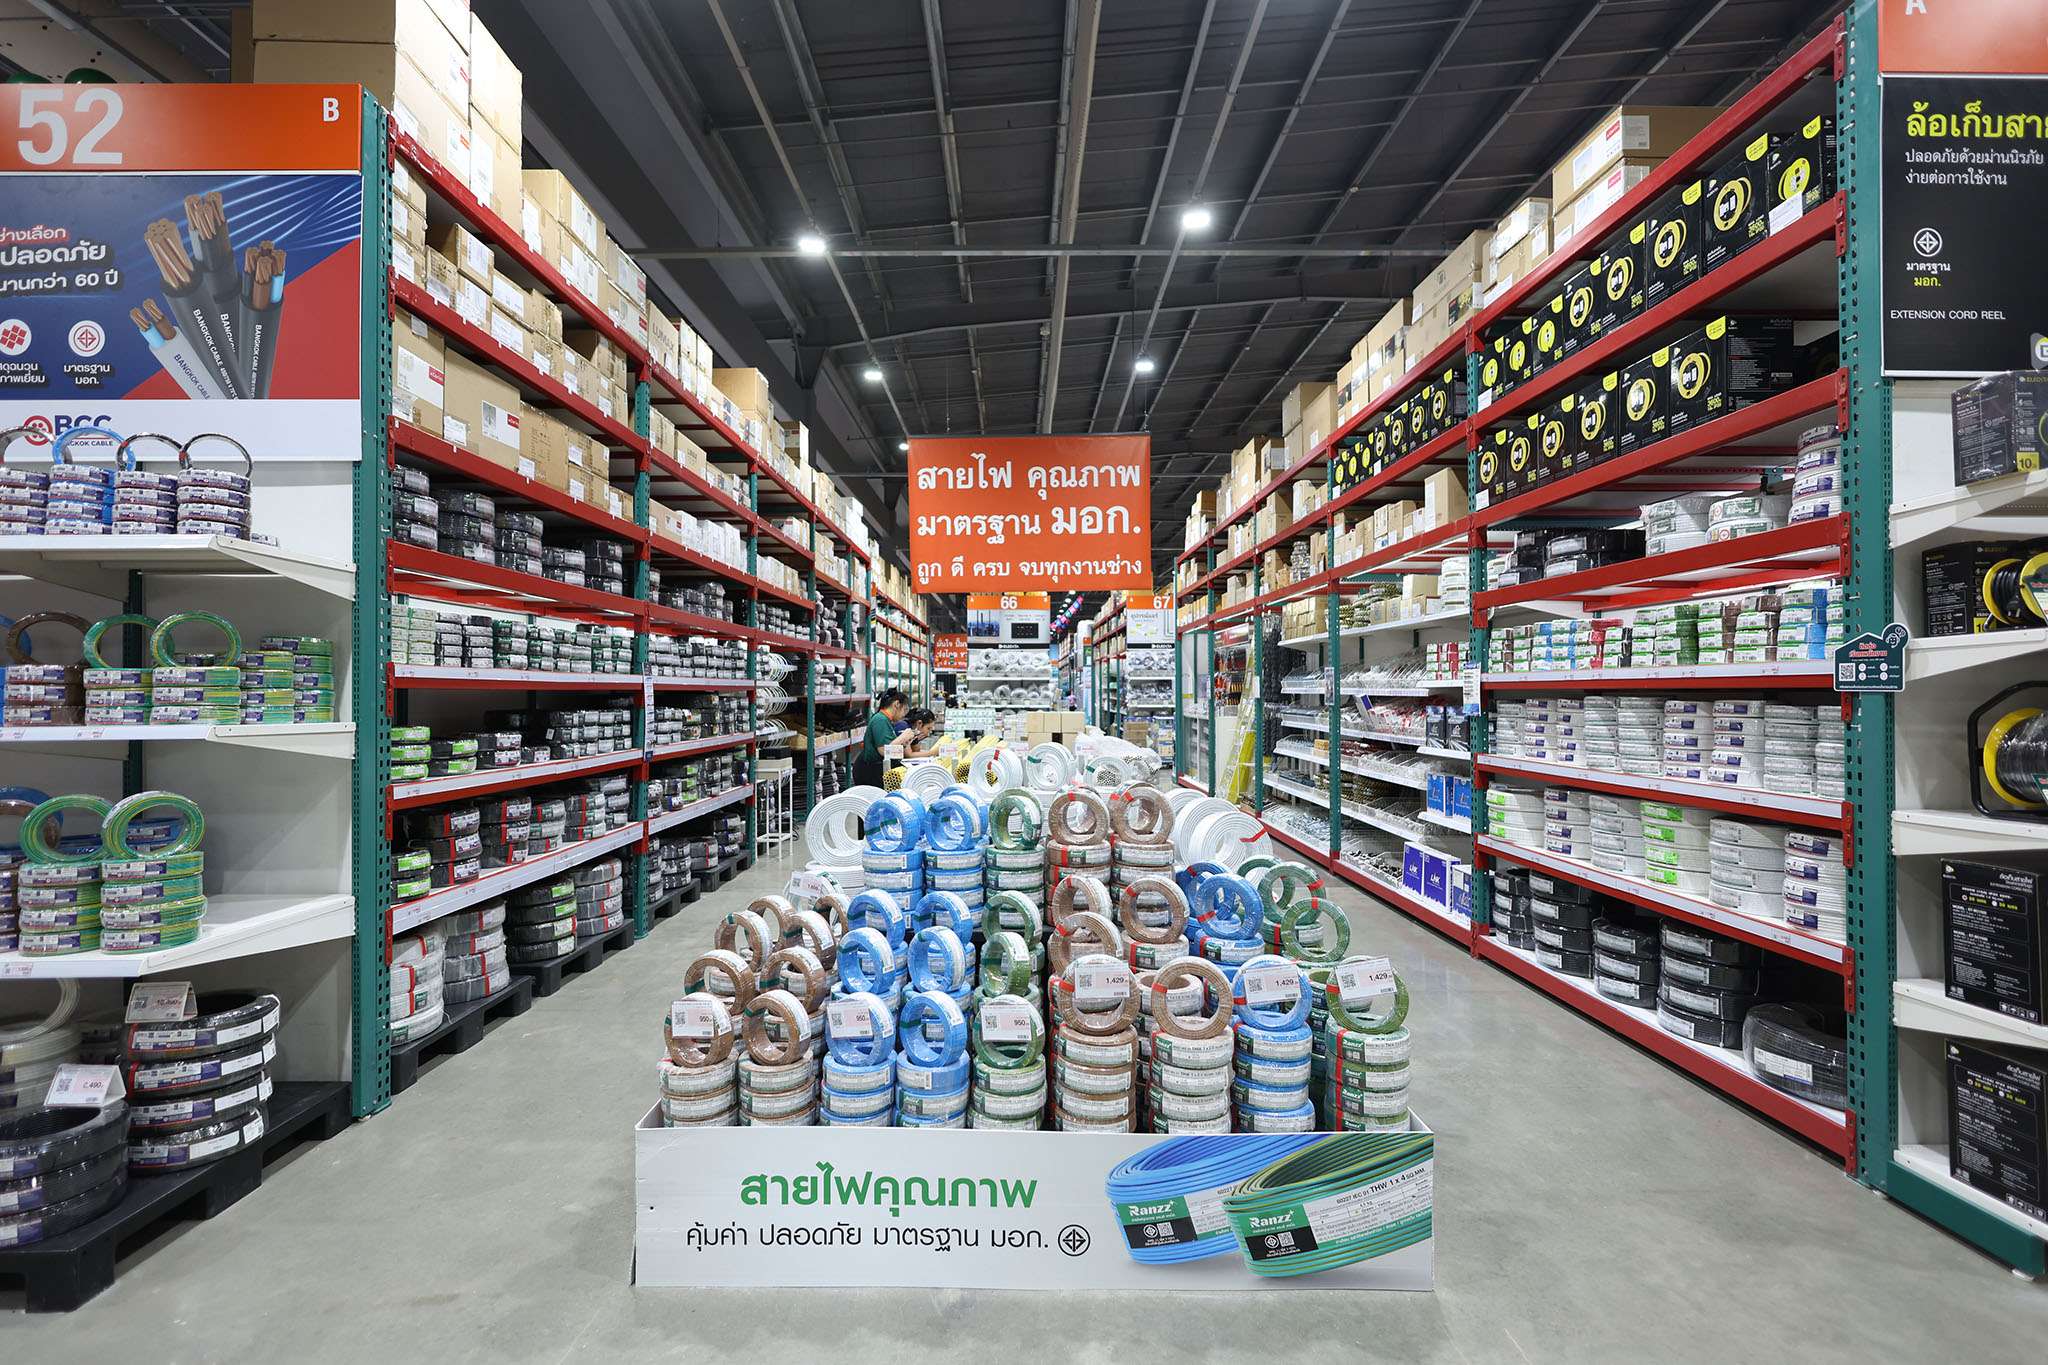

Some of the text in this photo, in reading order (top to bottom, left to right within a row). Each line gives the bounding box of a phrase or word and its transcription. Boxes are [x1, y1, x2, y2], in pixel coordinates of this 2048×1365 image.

[1905, 0, 1927, 15] A
[323, 98, 340, 122] B
[18, 88, 124, 165] 52
[1906, 101, 2048, 138] ล้อเก็บสา
[1905, 148, 2044, 165] ปลอดภัยด้วยม่านนิรภัย
[1905, 168, 2008, 186] ง่ายต่อการใช้งาน
[1, 240, 106, 266] ปลอดภัย
[1906, 262, 1951, 273] มาตรฐาน
[75, 273, 99, 287] 60
[105, 268, 119, 285] ปี
[1914, 276, 1941, 287] มอก.
[1891, 310, 2006, 320] EXTENSION CORD REEL
[193, 308, 214, 347] BANGKOK
[64, 364, 110, 375] มาตรฐาน
[174, 353, 198, 386] BANGKOK
[75, 376, 99, 385] มอก.
[2019, 459, 2032, 469] 10
[917, 453, 1140, 500] สายไฟ คุณภาพ
[917, 506, 1141, 545] มาตรฐาน มอก.
[918, 557, 1142, 584] ถูก ดี ครบ จบทุกงานช่าง
[1001, 597, 1017, 609] 66
[1153, 596, 1170, 608] 67
[1276, 979, 1294, 987] 1,429
[1369, 973, 1388, 982] 1,429
[740, 1160, 1037, 1217] สายไฟคุณภาพ
[1370, 1182, 1388, 1193] THW
[1129, 1204, 1172, 1217] Ranzz
[1250, 1212, 1292, 1229] Ranzz
[686, 1221, 1049, 1252] คุ้มค่า ปลอดภัย มาตรฐาน มอก.
